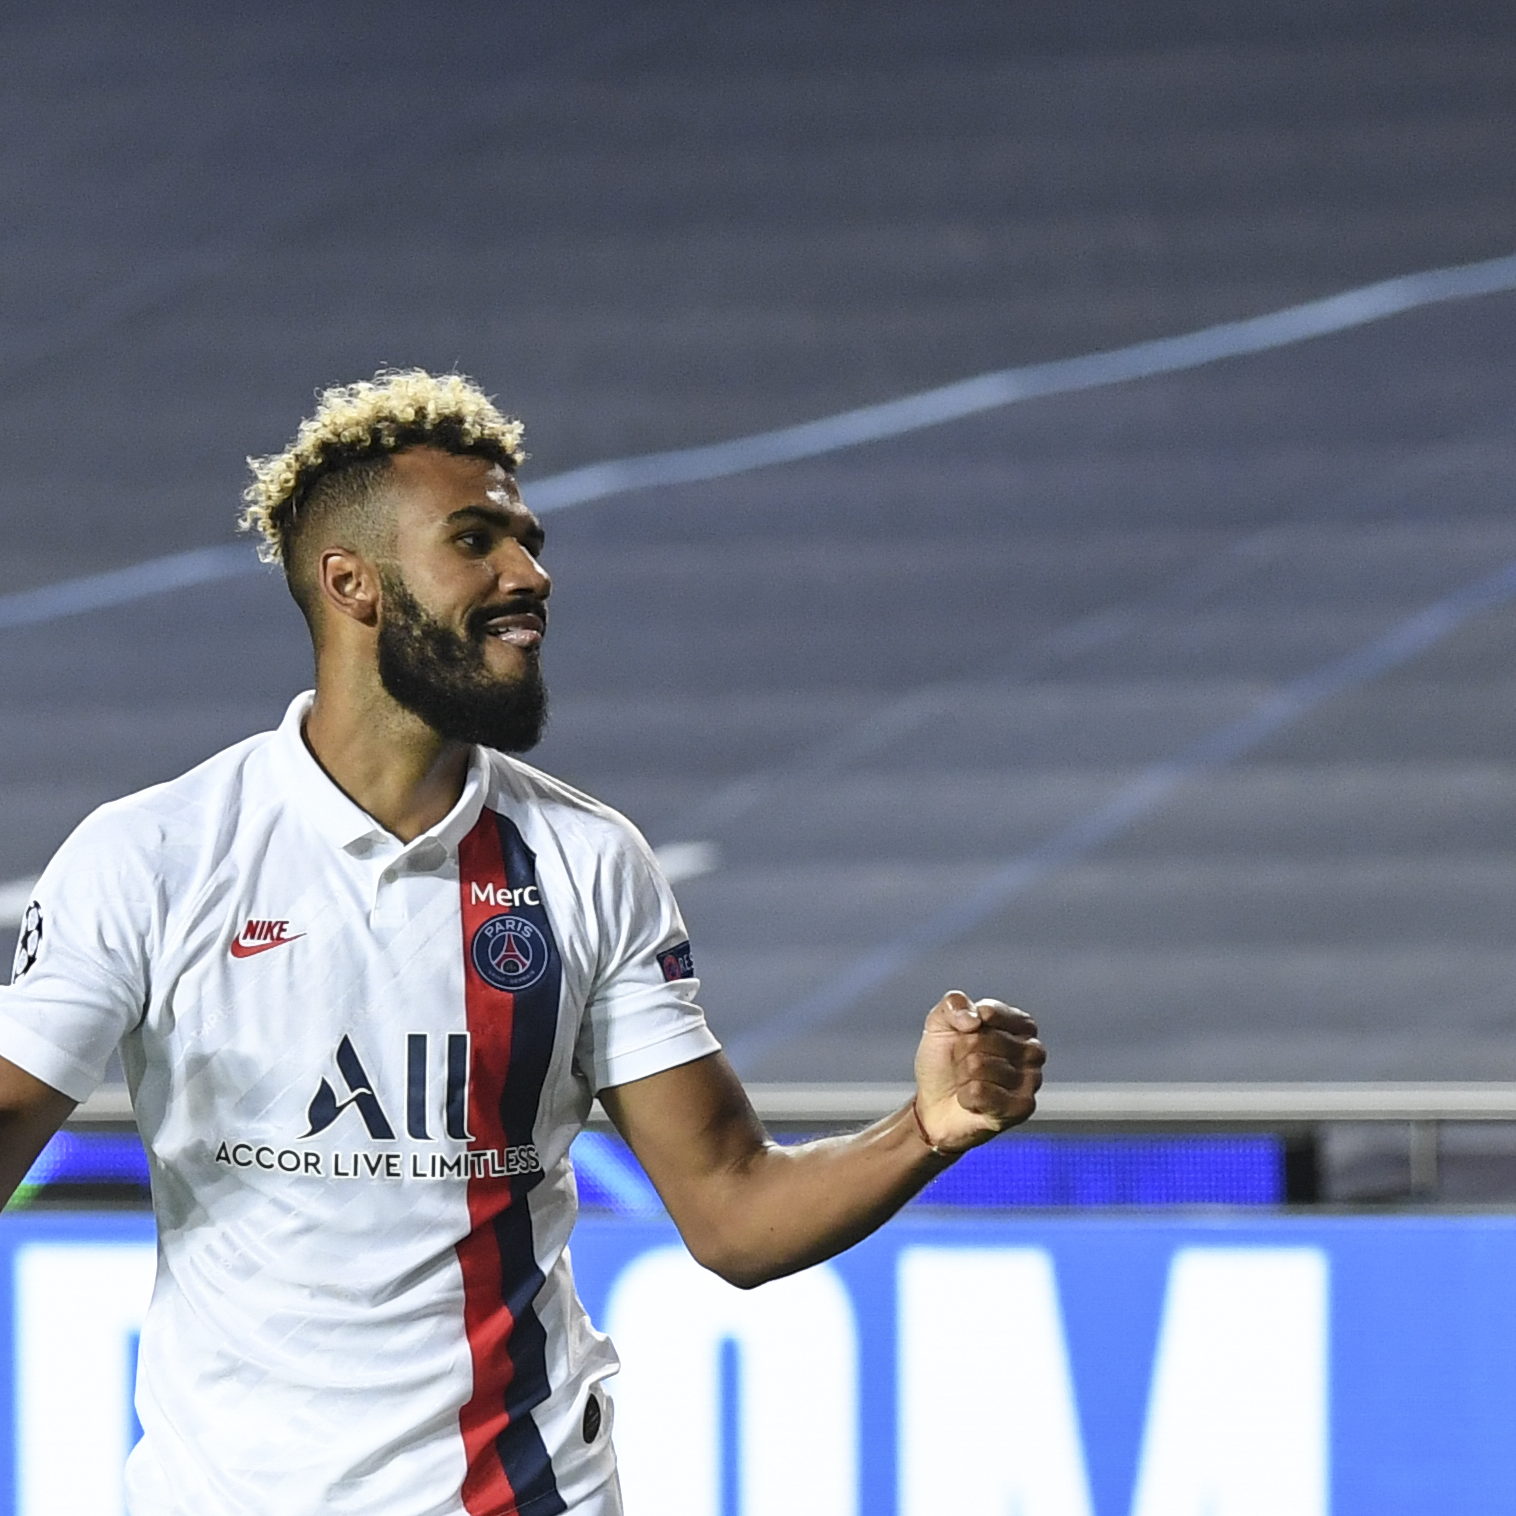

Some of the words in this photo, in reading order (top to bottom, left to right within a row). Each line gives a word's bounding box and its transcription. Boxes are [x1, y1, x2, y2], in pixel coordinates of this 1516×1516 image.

[242, 919, 290, 942] NIKE
[483, 919, 534, 938] PARIS
[214, 1140, 323, 1176] ACCOR
[333, 1152, 402, 1178] LIVE
[411, 1144, 541, 1179] LIMITLESS
